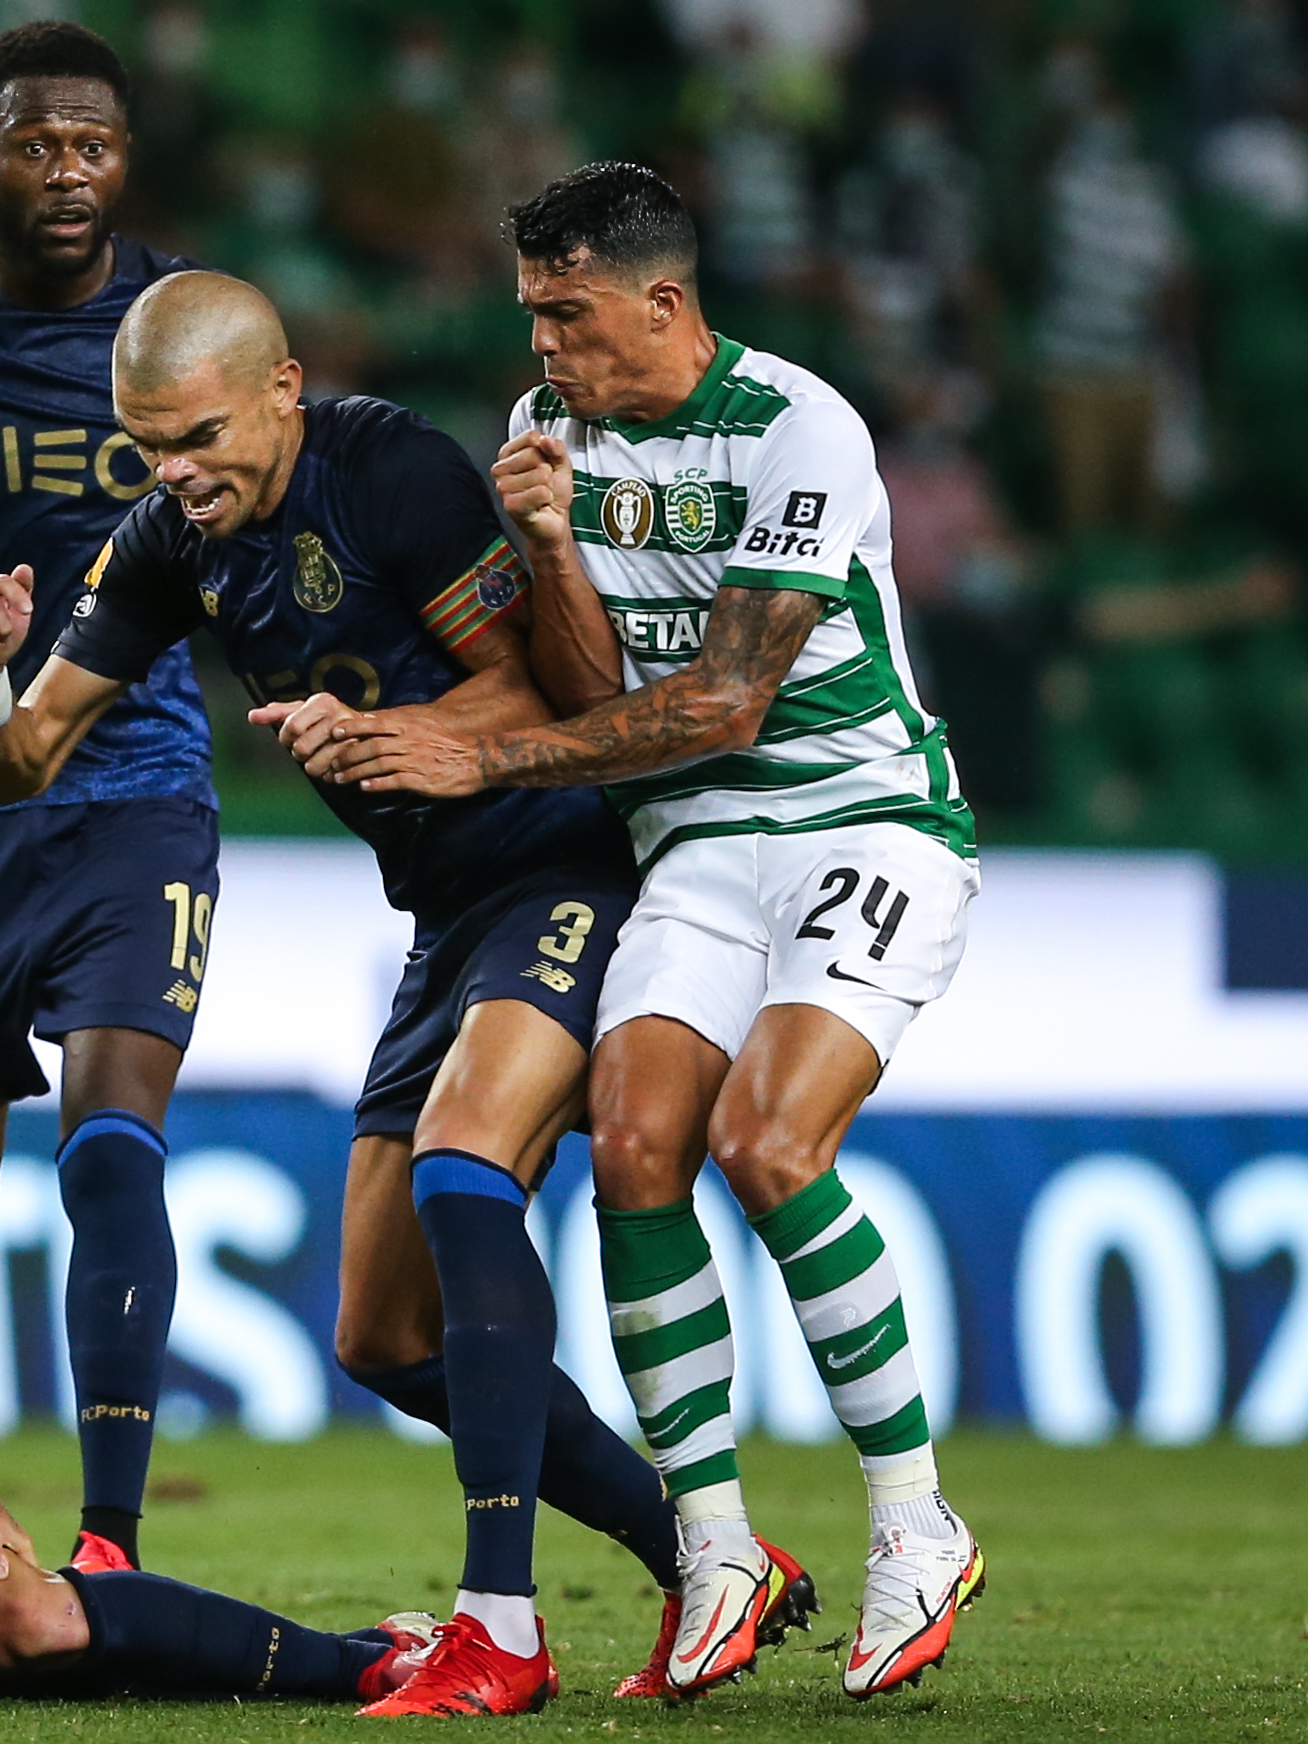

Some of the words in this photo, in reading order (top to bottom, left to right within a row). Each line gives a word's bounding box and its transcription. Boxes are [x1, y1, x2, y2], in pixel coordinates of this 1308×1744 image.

[673, 467, 708, 483] SCP
[669, 484, 710, 504] SPORTING
[674, 529, 711, 544] PORTUGAL
[743, 526, 825, 557] Bitci
[795, 867, 910, 962] 24
[164, 881, 212, 983] 19
[537, 901, 595, 964] 3
